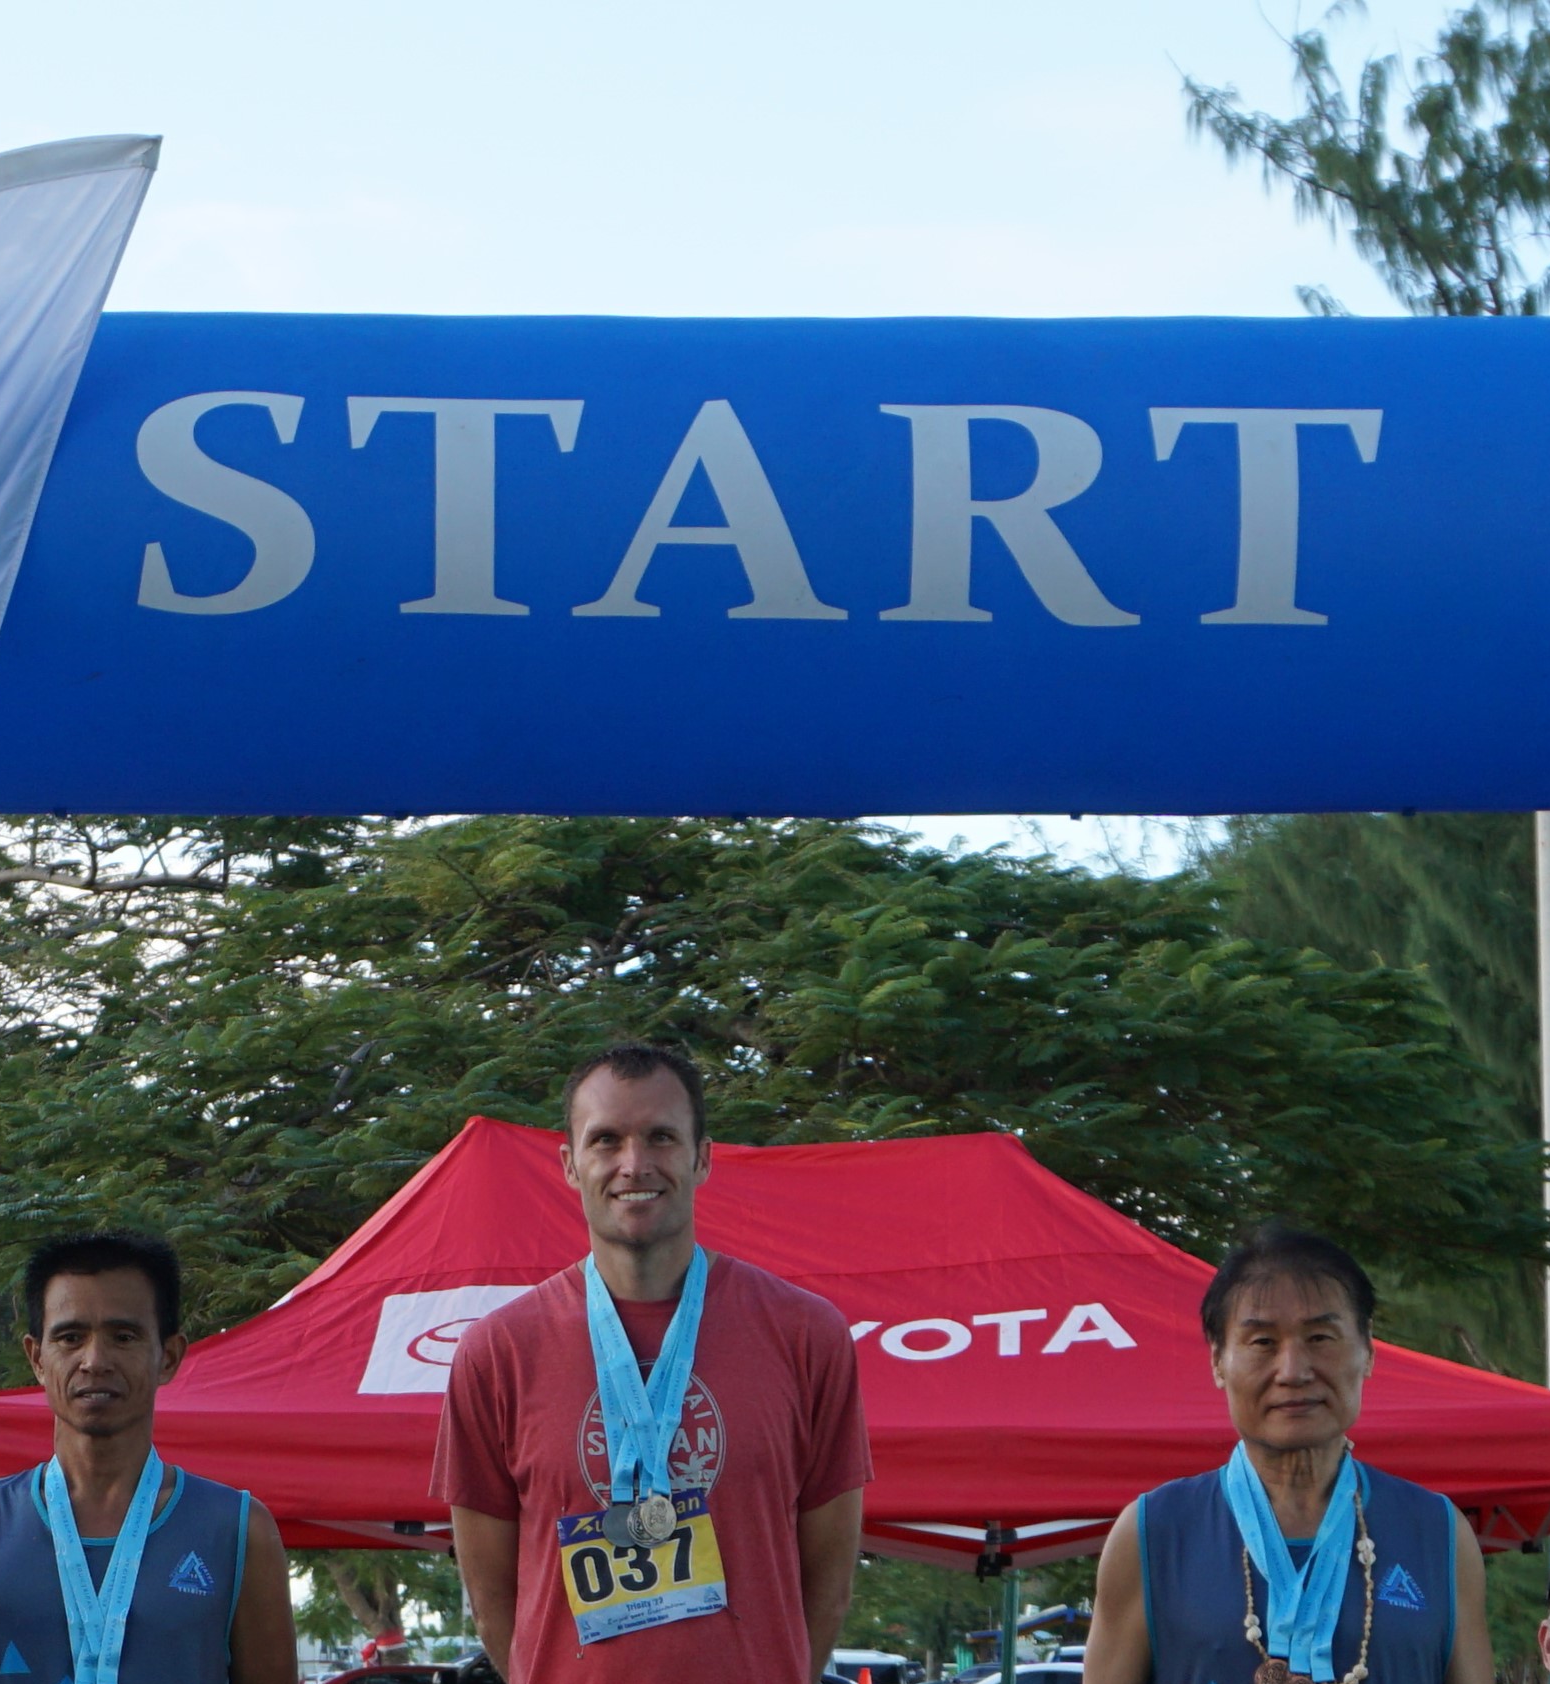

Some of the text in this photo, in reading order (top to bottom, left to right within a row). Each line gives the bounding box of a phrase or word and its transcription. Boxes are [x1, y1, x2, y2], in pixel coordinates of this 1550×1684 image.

[134, 390, 1385, 628] START
[587, 1427, 718, 1456] SAN
[569, 1524, 694, 1604] 037
